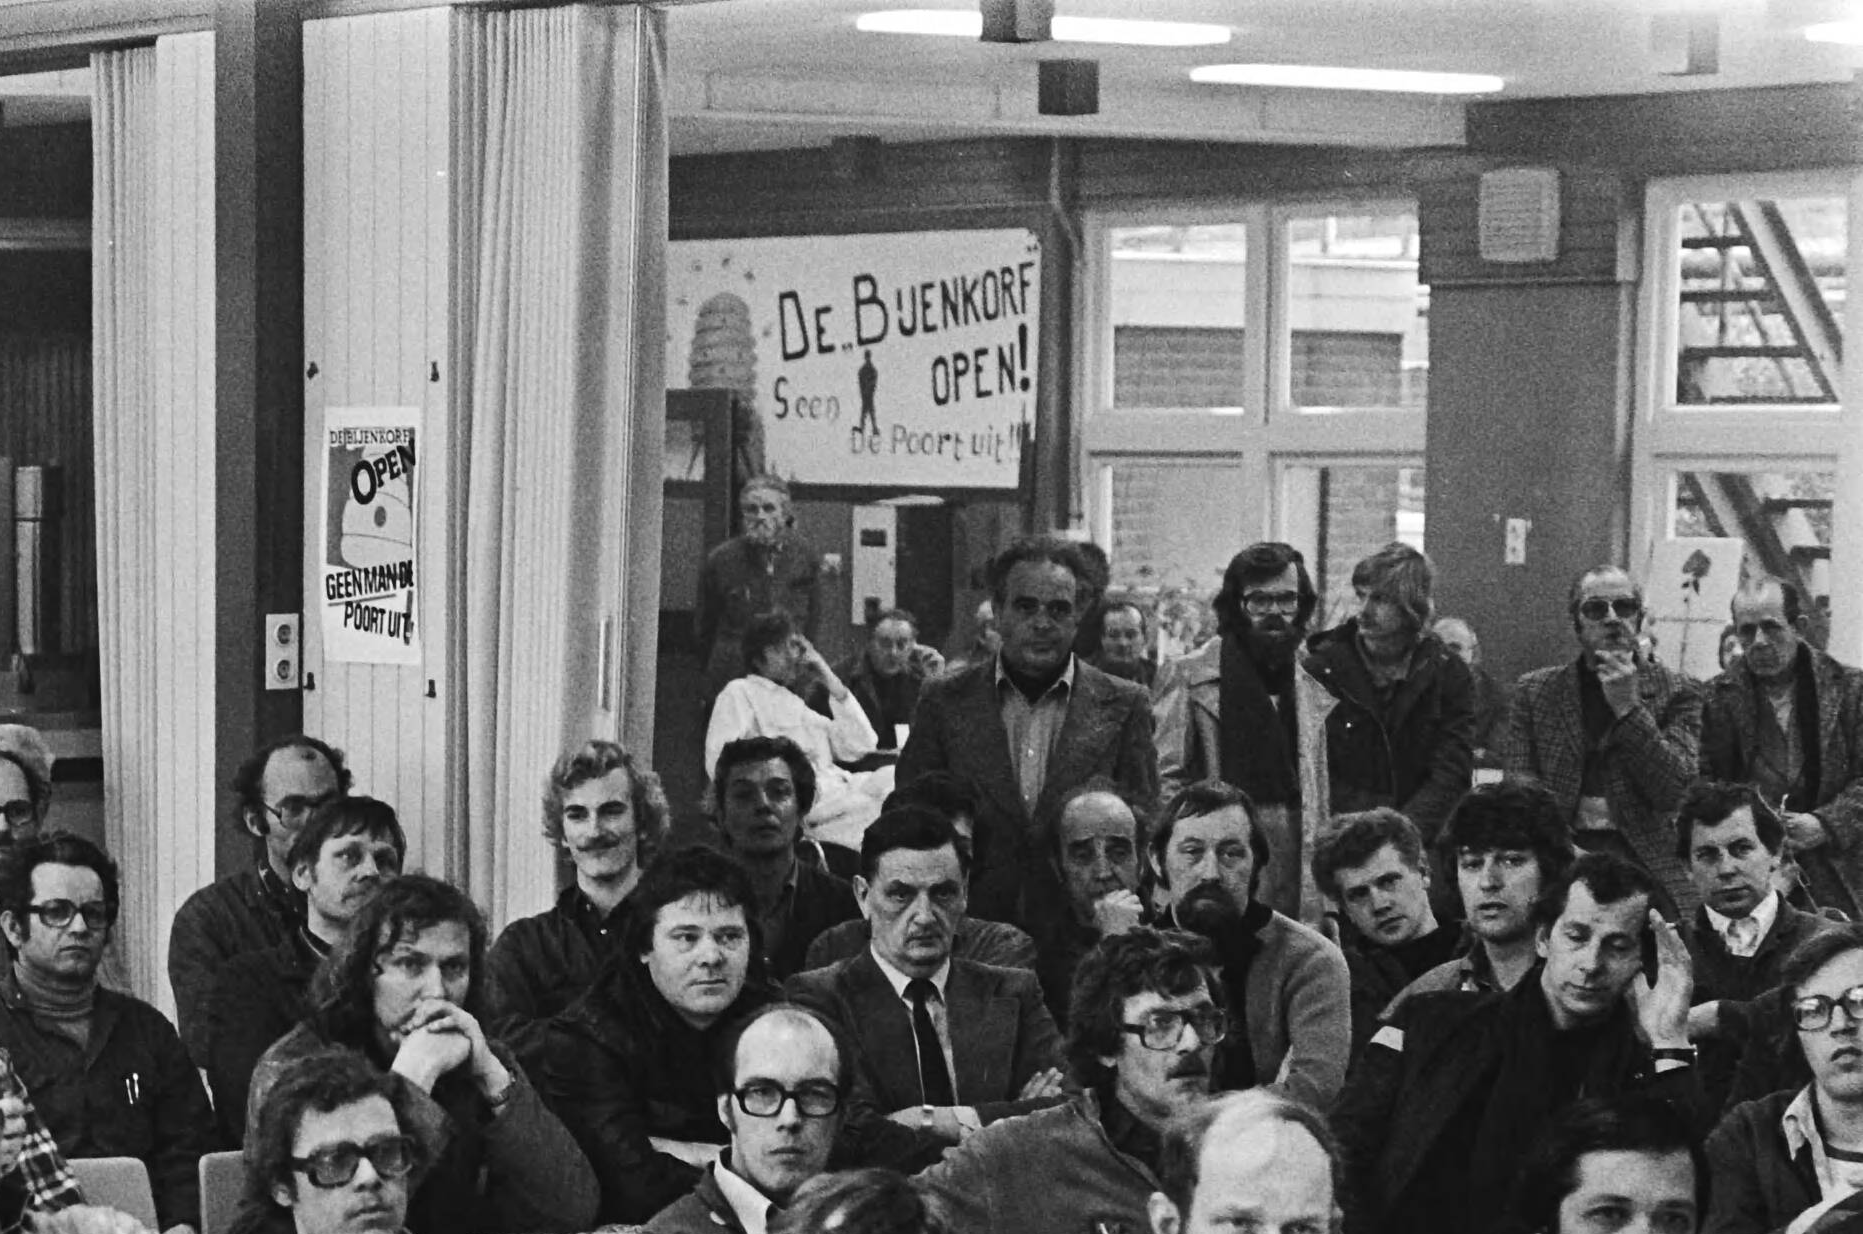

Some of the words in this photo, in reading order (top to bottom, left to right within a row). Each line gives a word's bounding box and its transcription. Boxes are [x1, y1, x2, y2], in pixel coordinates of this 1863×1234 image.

[931, 321, 1031, 406] OPEN!
[891, 423, 965, 462] Poort
[351, 437, 416, 505] OPEN
[325, 568, 363, 600] GEEN
[363, 563, 397, 594] MAN
[344, 600, 387, 635] POORT
